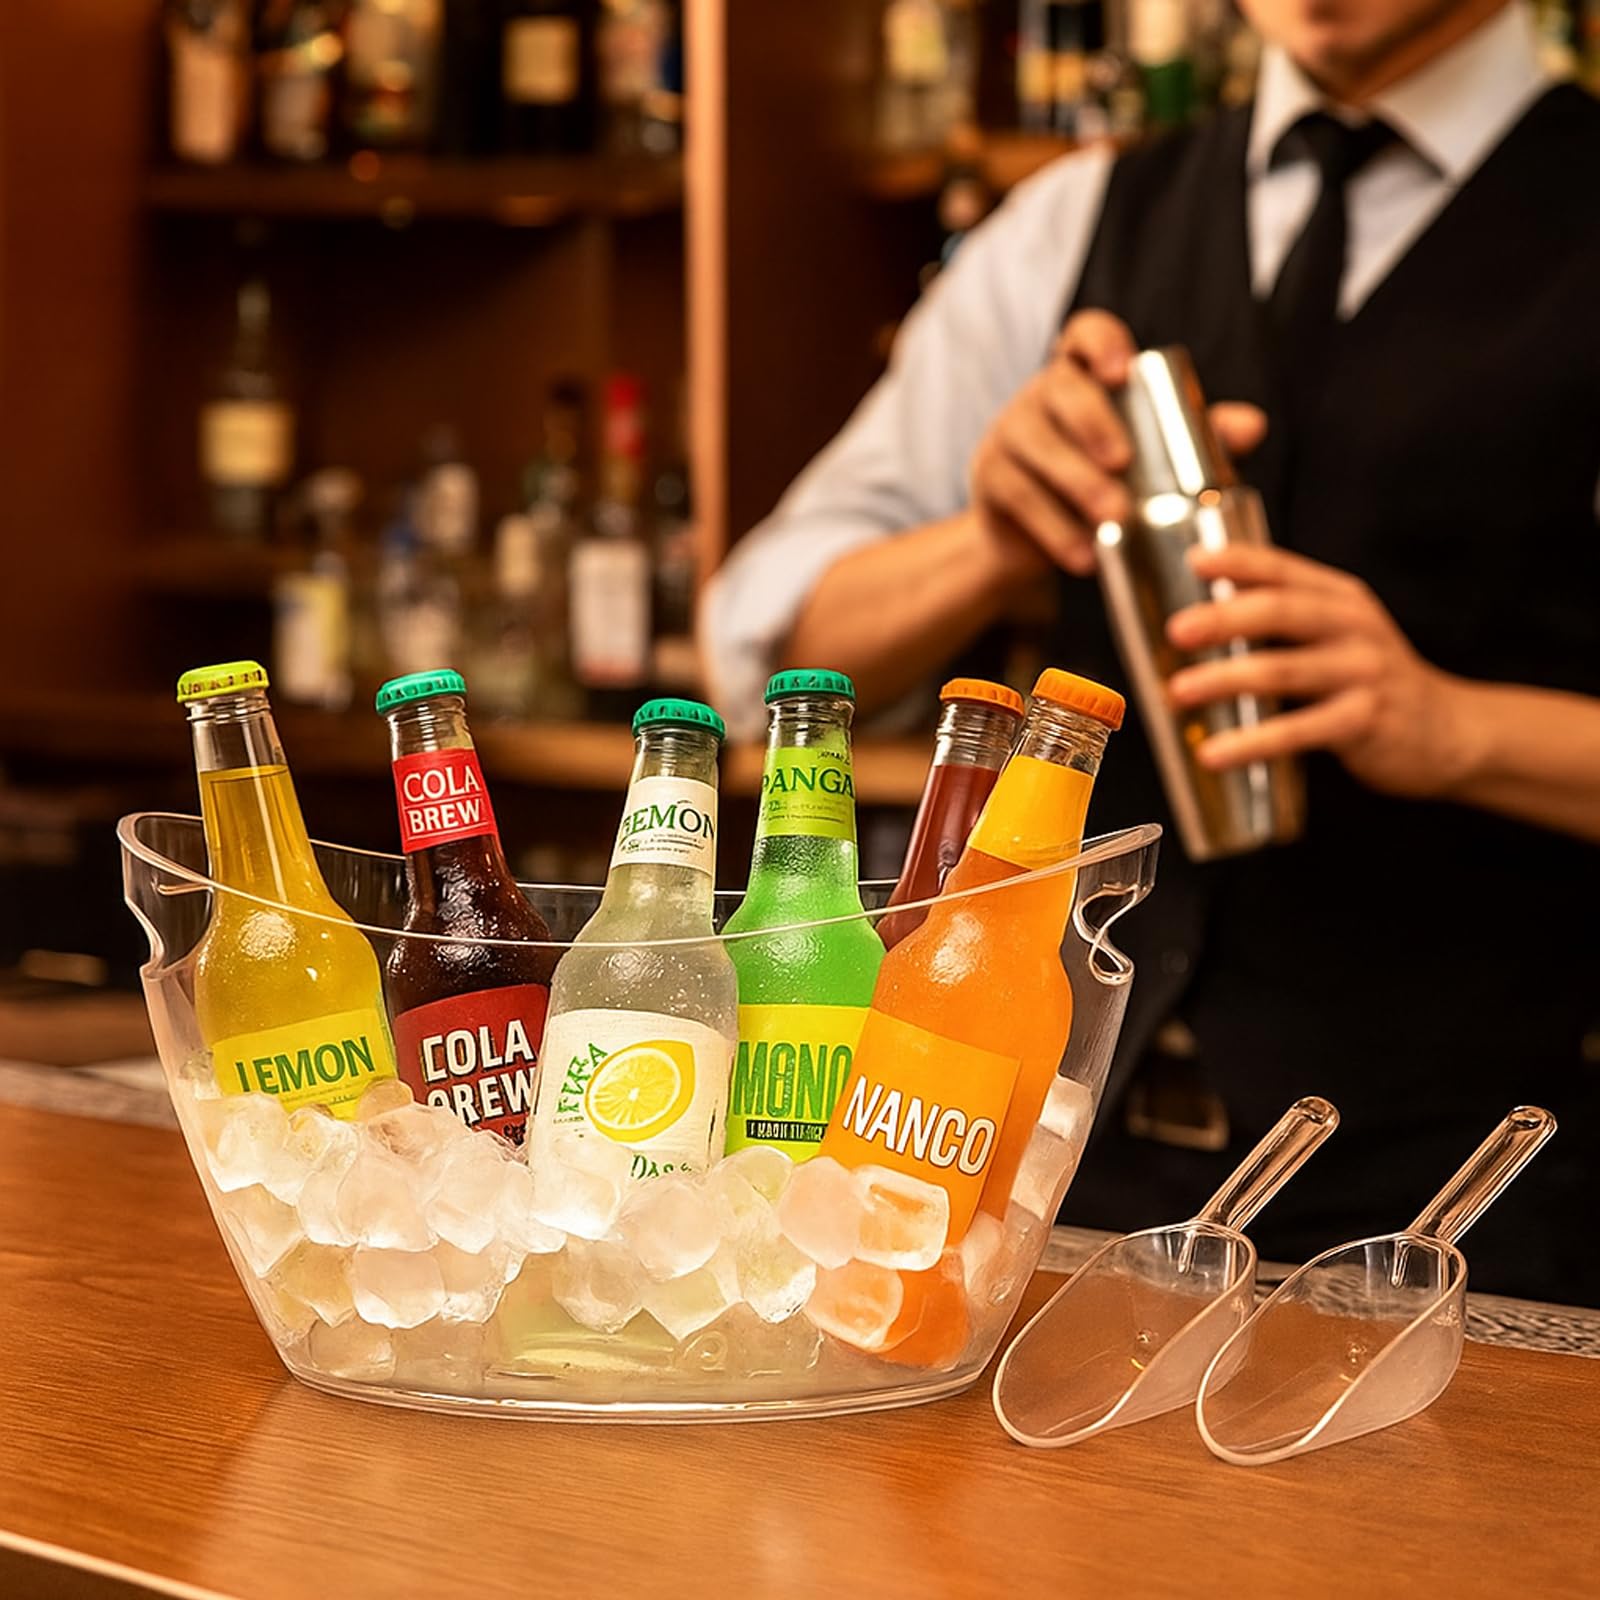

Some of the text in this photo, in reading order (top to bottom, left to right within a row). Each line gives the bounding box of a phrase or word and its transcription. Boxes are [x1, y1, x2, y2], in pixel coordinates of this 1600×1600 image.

[403, 766, 480, 802] COLA
[409, 798, 481, 834] BREW
[422, 1019, 535, 1082] COLA
[842, 1075, 996, 1176] NANCO
